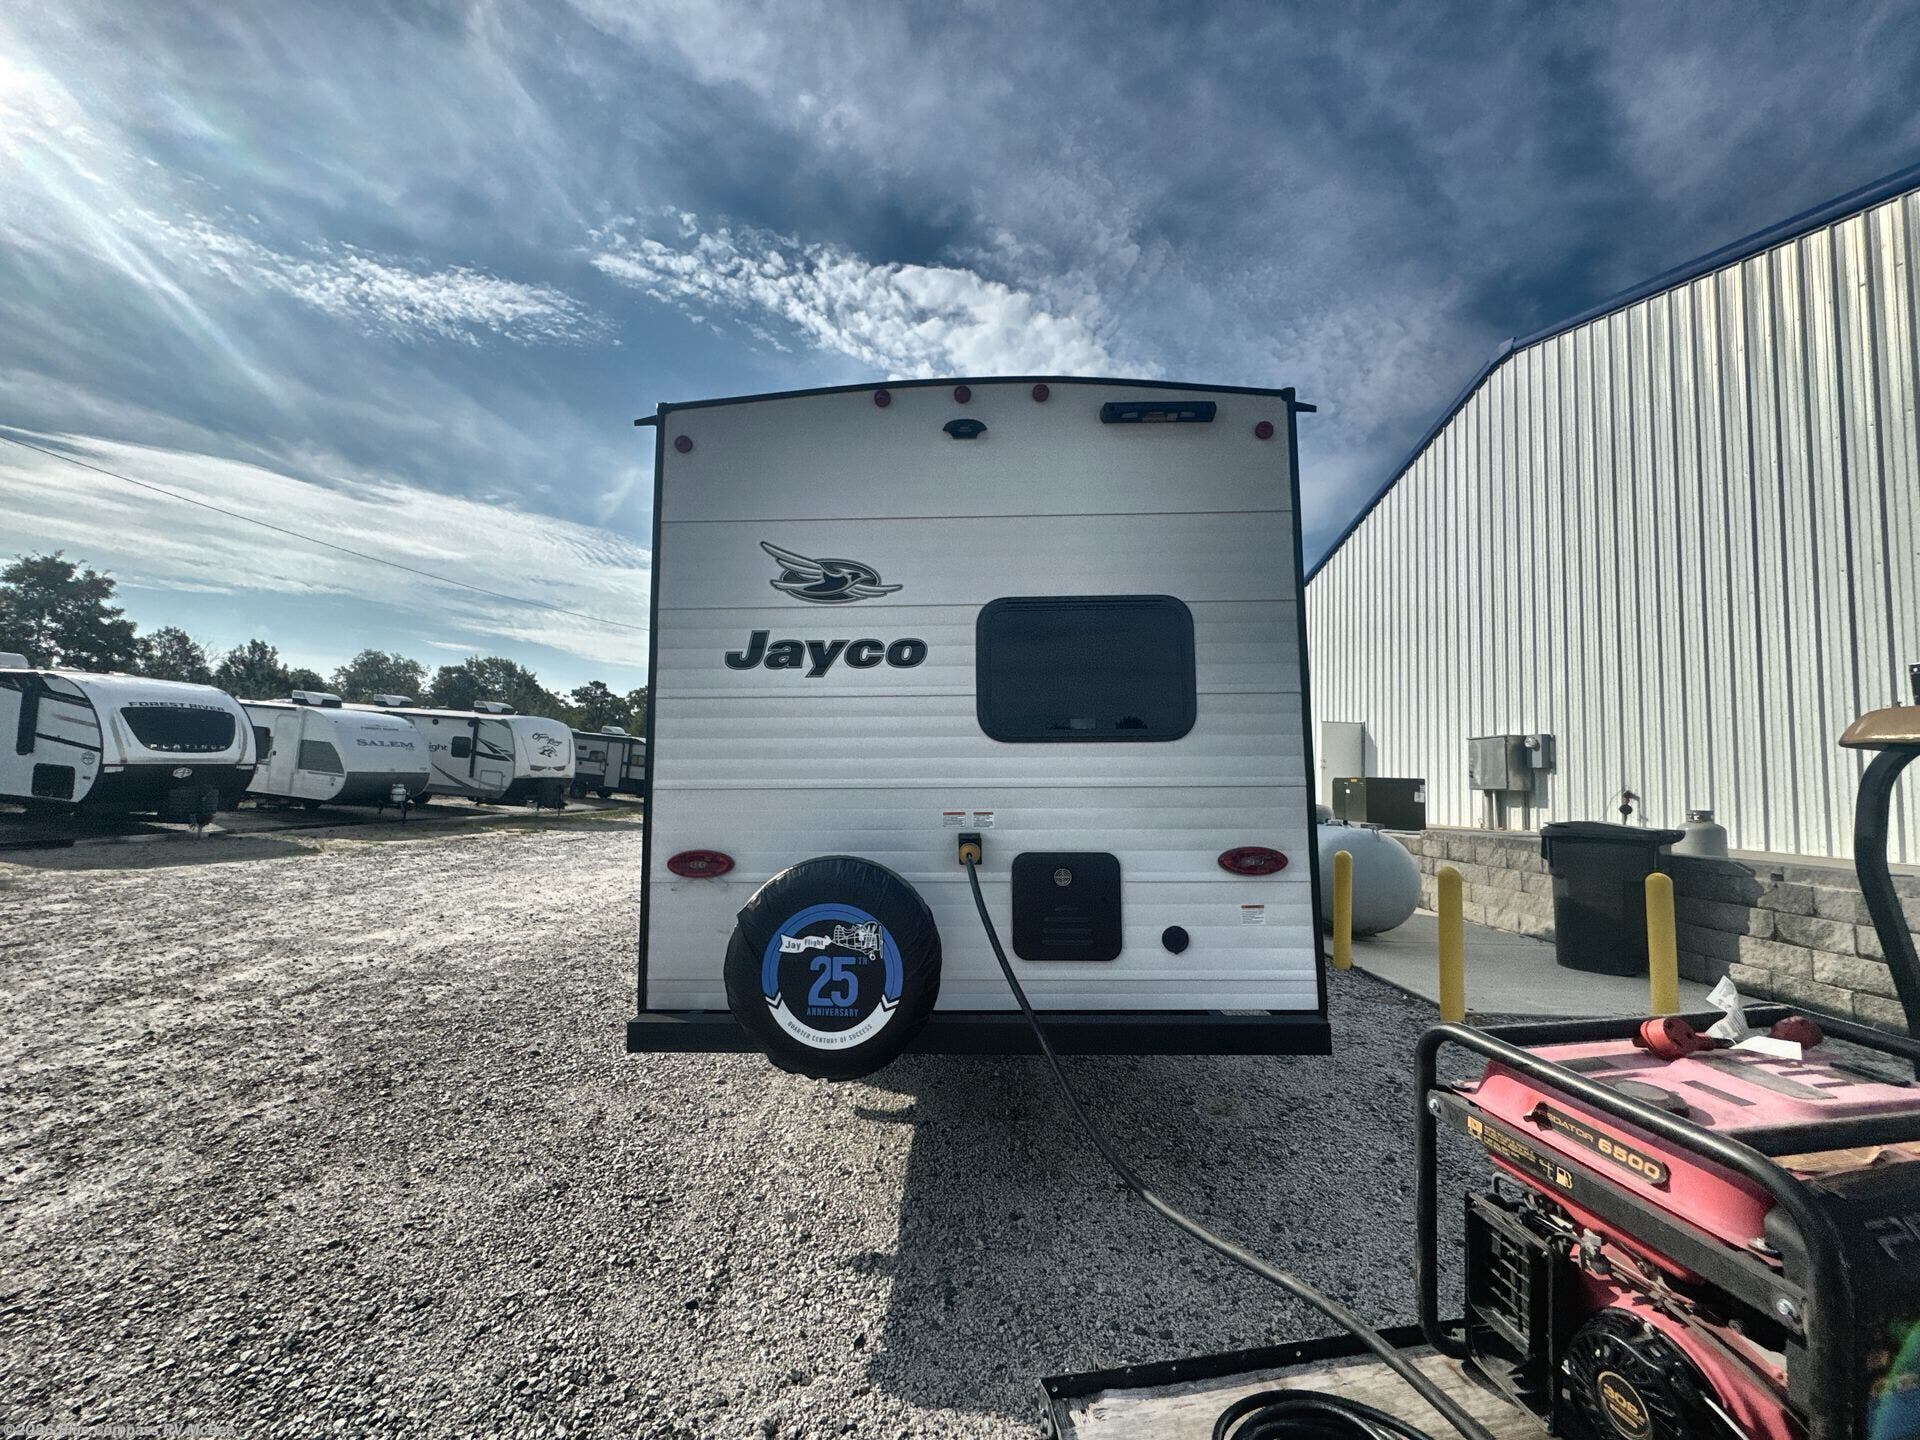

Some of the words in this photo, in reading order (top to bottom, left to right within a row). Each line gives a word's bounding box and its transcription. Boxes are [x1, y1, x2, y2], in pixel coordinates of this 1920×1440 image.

[724, 630, 928, 678] Jayco
[128, 701, 187, 709] FOREST
[188, 703, 225, 712] RIVER
[356, 738, 415, 749] SALEM
[428, 742, 447, 753] ight
[785, 940, 802, 951] Jay
[804, 938, 824, 947] Flight
[808, 955, 859, 1008] 25
[858, 956, 868, 965] TH
[806, 1007, 860, 1017] ANNIVERSARY
[787, 1020, 811, 1039] QUARTER
[811, 1035, 838, 1044] CENTURY
[848, 1023, 873, 1041] SUCCESS
[1540, 1108, 1594, 1142] EDATOR
[1597, 1137, 1661, 1181] 6500
